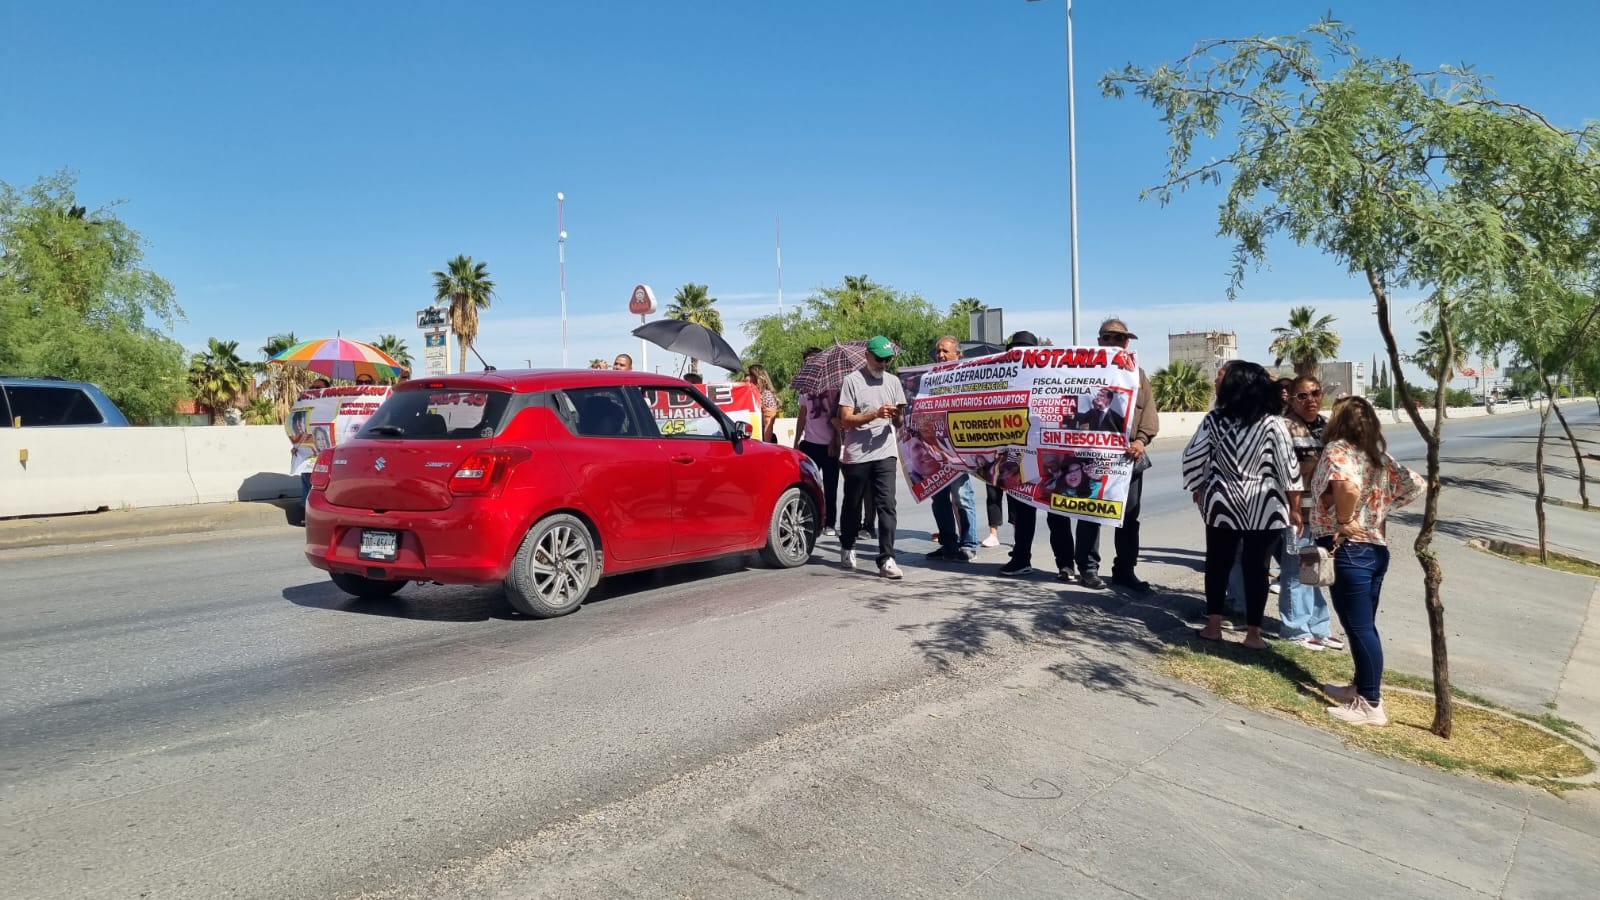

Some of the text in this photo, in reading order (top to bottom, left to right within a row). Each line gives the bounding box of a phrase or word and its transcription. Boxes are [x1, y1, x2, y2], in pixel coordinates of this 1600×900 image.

[1022, 348, 1108, 369] NOTARIA
[924, 365, 1018, 387] FAMILIAS DEFRAUDADAS
[1033, 377, 1108, 386] FISCAL GENERAL
[1032, 387, 1091, 395] DE COAHUILA
[934, 398, 950, 409] PARA
[951, 396, 983, 408] NOTARIOS
[984, 393, 1027, 406] CORRUPTOS!
[1032, 398, 1076, 407] DENUNCIA
[1032, 406, 1059, 414] DESDE
[953, 414, 1023, 430] A TORREÓN NO
[1041, 414, 1063, 422] 2020
[661, 420, 686, 434] 45
[955, 434, 965, 442] LE
[1043, 431, 1126, 447] SIN RESOLVER
[1052, 496, 1117, 515] LADRONA
